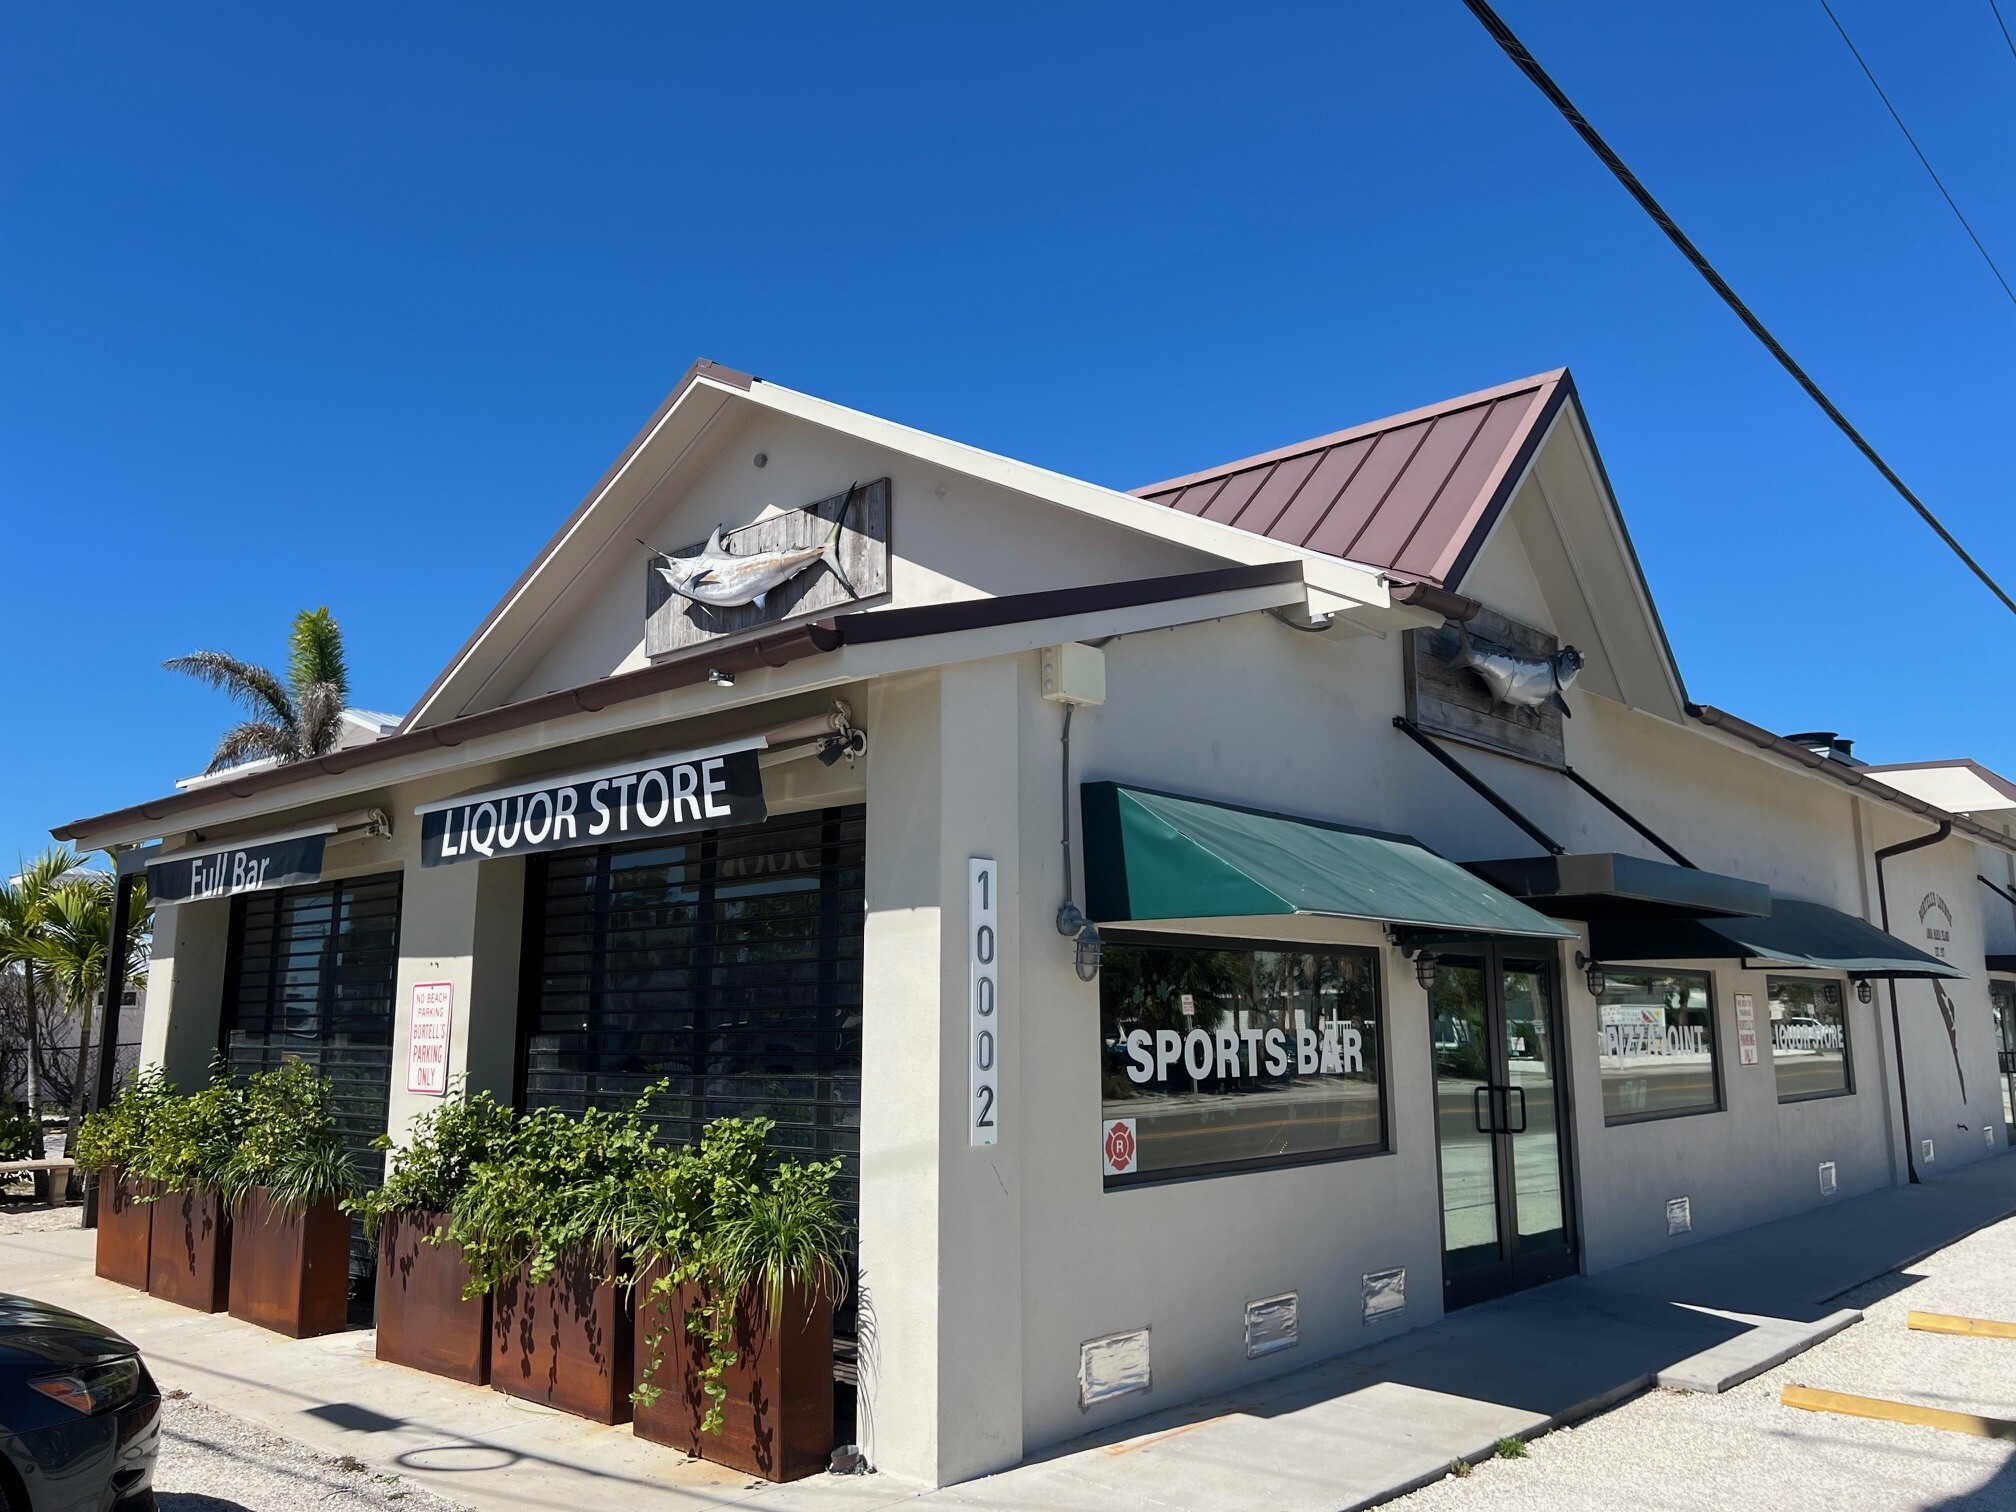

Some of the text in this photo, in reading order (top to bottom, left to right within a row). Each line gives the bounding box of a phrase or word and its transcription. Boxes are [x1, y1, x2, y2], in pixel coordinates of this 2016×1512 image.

[441, 757, 731, 858] LIQUOR STORE
[190, 851, 270, 899] Full Bar
[416, 992, 447, 1004] NO BEACH
[976, 870, 994, 1128] 10002
[418, 1007, 444, 1018] PARKING
[413, 1024, 446, 1039] BORTELL'S
[413, 1045, 443, 1063] PARKING
[1126, 1028, 1363, 1083] SPORTS BAR
[417, 1068, 435, 1087] ONLY
[1116, 1139, 1124, 1154] R
